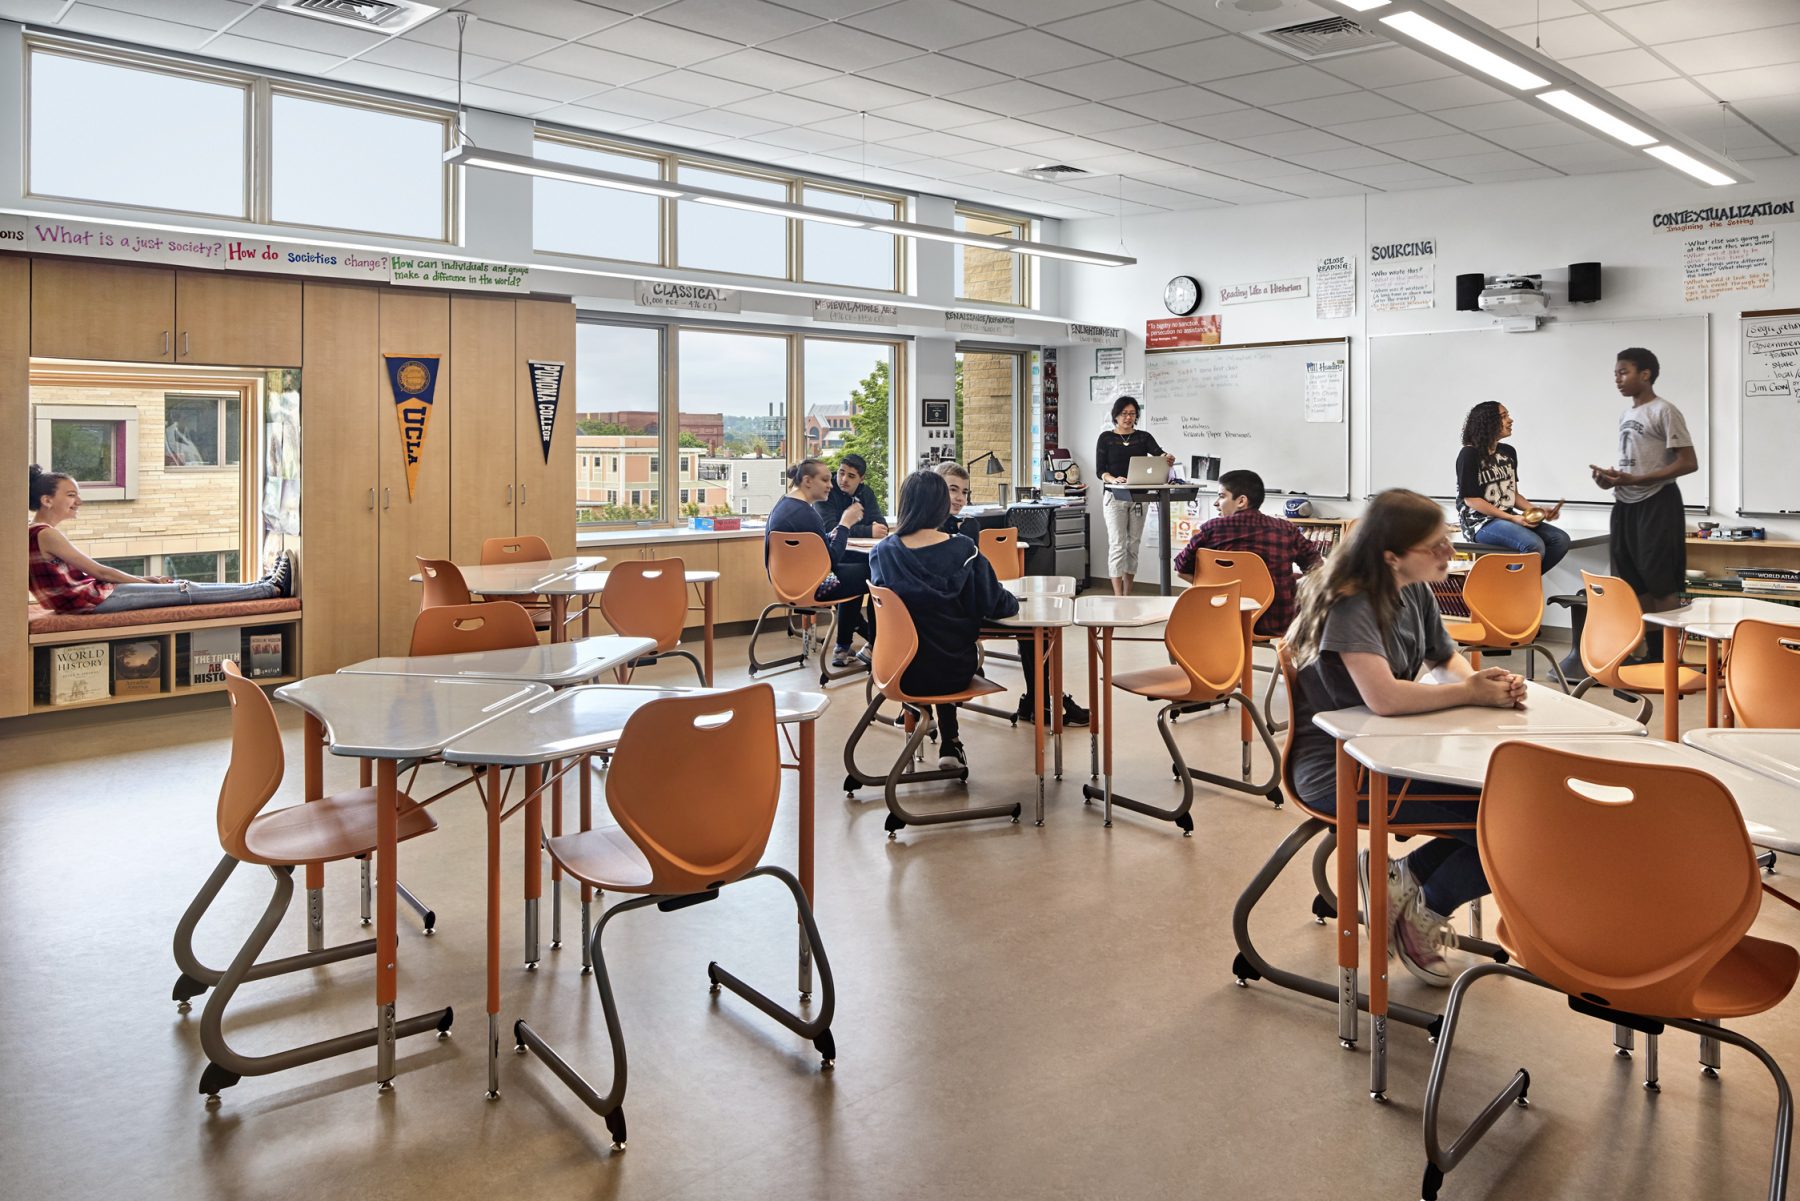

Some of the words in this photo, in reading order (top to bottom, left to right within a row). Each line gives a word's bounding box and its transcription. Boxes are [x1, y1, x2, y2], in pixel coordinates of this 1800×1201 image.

[1653, 201, 1795, 228] CONTEXTUALIZATION
[1667, 224, 1703, 232] Imagining
[1710, 221, 1722, 229] the
[1727, 218, 1754, 227] Setting
[35, 224, 93, 246] What
[100, 231, 114, 247] is
[120, 237, 130, 248] a
[132, 236, 162, 252] just
[168, 241, 222, 258] society?
[229, 242, 256, 262] How
[261, 245, 279, 260] do
[344, 256, 388, 272] change?
[1372, 241, 1434, 261] SOURCING
[392, 256, 414, 270] How
[417, 260, 438, 270] can
[441, 260, 489, 273] individuals
[492, 264, 506, 273] and
[1324, 256, 1344, 266] CLOSE
[1687, 262, 1705, 270] What
[395, 270, 420, 281] make
[423, 273, 429, 281] a
[432, 271, 466, 283] difference
[469, 274, 477, 284] in
[479, 276, 492, 286] the
[494, 276, 522, 288] world?
[652, 284, 727, 302] CLASSICAL
[1221, 287, 1248, 302] Reading
[1270, 284, 1302, 294] Historian
[1071, 324, 1120, 338] ENLIGHTENMENT
[1752, 340, 1800, 353] governmen
[534, 363, 560, 402] POMONA
[1749, 382, 1767, 392] Jim
[1769, 382, 1788, 392] Crow
[538, 404, 555, 442] COLLEGE
[402, 406, 427, 466] UCLA
[57, 649, 105, 662] WORLD
[194, 656, 210, 664] THE
[212, 652, 240, 663] TRUTH
[58, 658, 104, 672] HISTORY
[208, 662, 240, 672] ABT
[194, 672, 226, 684] HISTO
